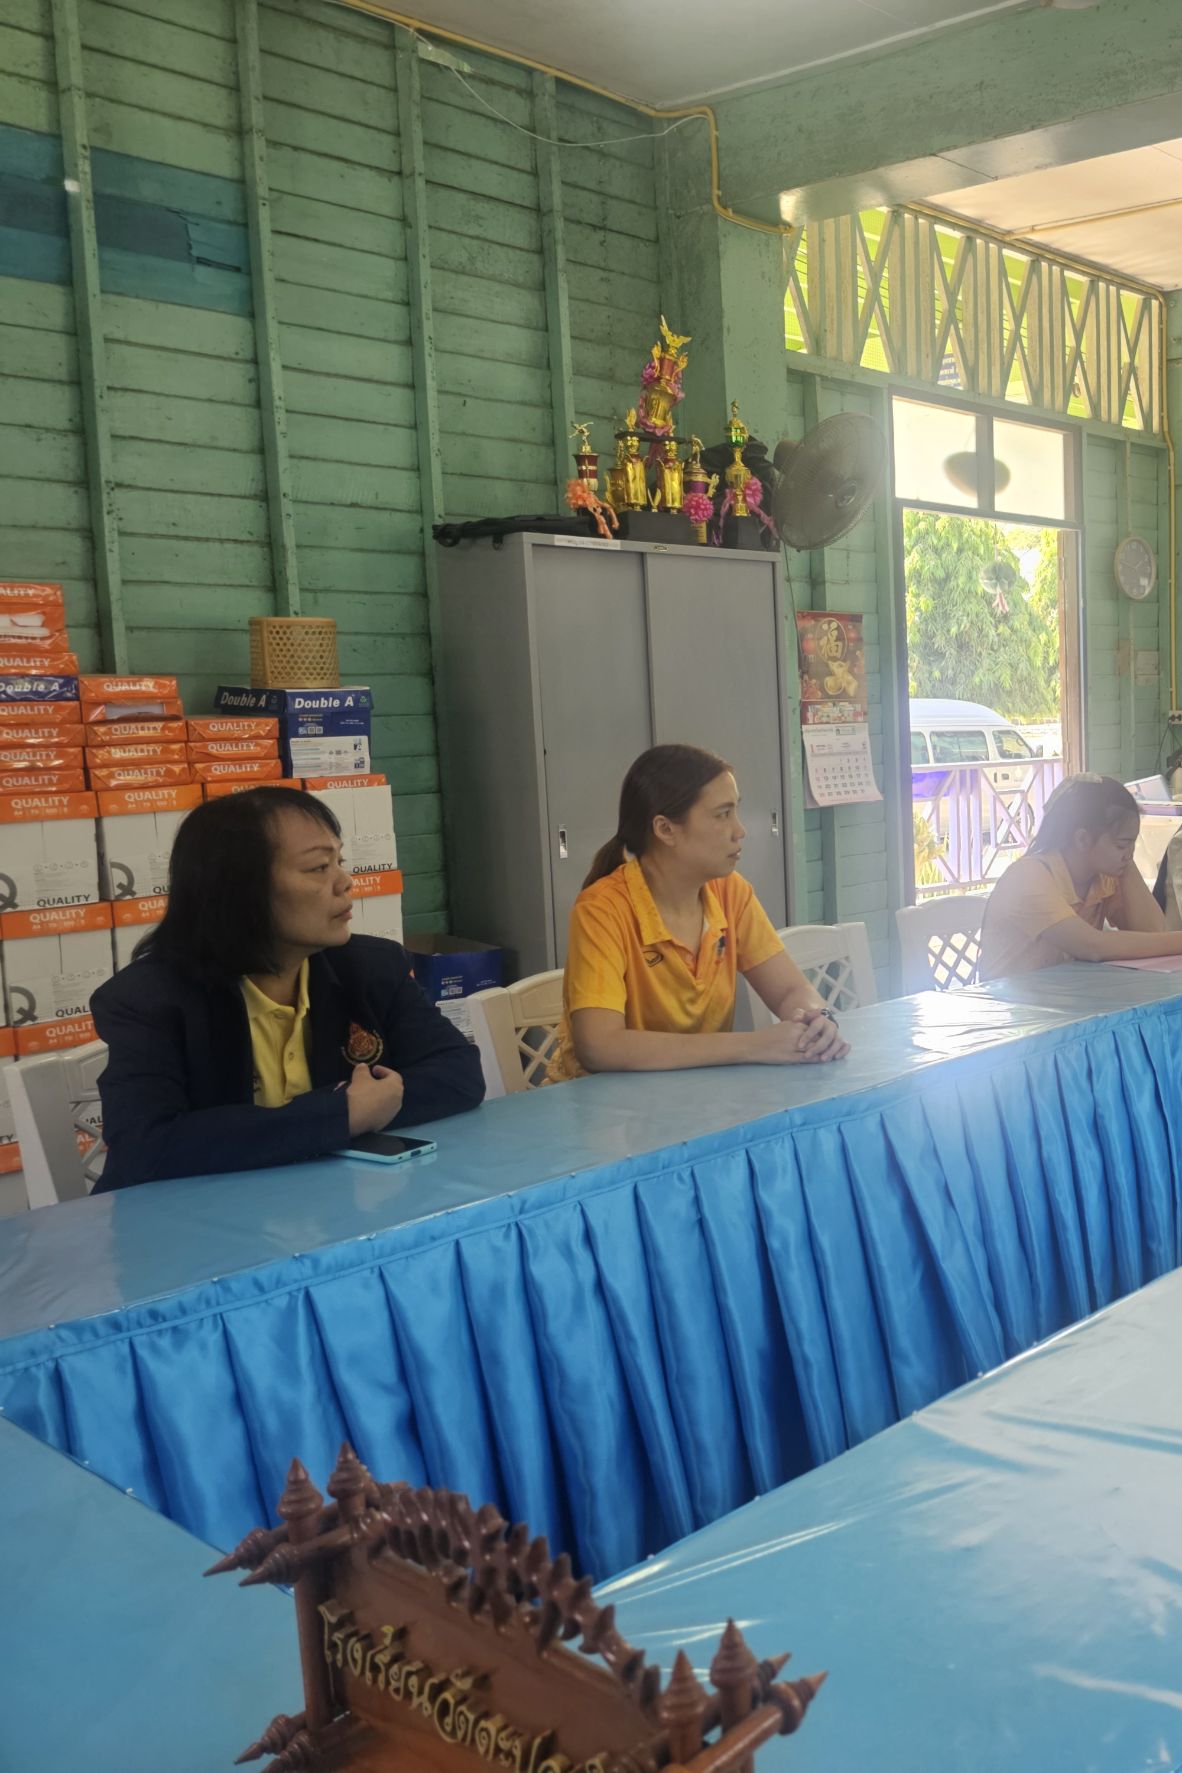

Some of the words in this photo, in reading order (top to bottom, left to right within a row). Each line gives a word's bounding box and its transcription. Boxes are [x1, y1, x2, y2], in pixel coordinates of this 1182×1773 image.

[50, 682, 60, 691] A
[103, 679, 156, 691] QUALITY
[220, 692, 256, 706] Double
[258, 694, 267, 708] A
[294, 696, 340, 709] Double
[344, 696, 354, 707] A
[0, 705, 55, 716] QUALITY
[112, 725, 162, 735] QUALITY
[209, 721, 257, 732] QUALITY
[2, 727, 59, 739] QUALITY
[208, 742, 256, 753] QUALITY
[0, 751, 57, 762] QUALITY
[115, 767, 166, 780] QUALITY
[211, 763, 260, 775] QUALITY
[2, 774, 59, 787] QUALITY
[327, 778, 370, 789] QUALITY
[124, 789, 178, 802] QUALITY
[11, 796, 70, 809] QUALITY
[352, 862, 393, 874] QUALITY
[351, 875, 382, 887] ALITY
[36, 894, 91, 908] QUALITY
[29, 908, 87, 923] QUALITY
[55, 1005, 90, 1018] QUAL
[45, 1020, 94, 1038] QUALIT
